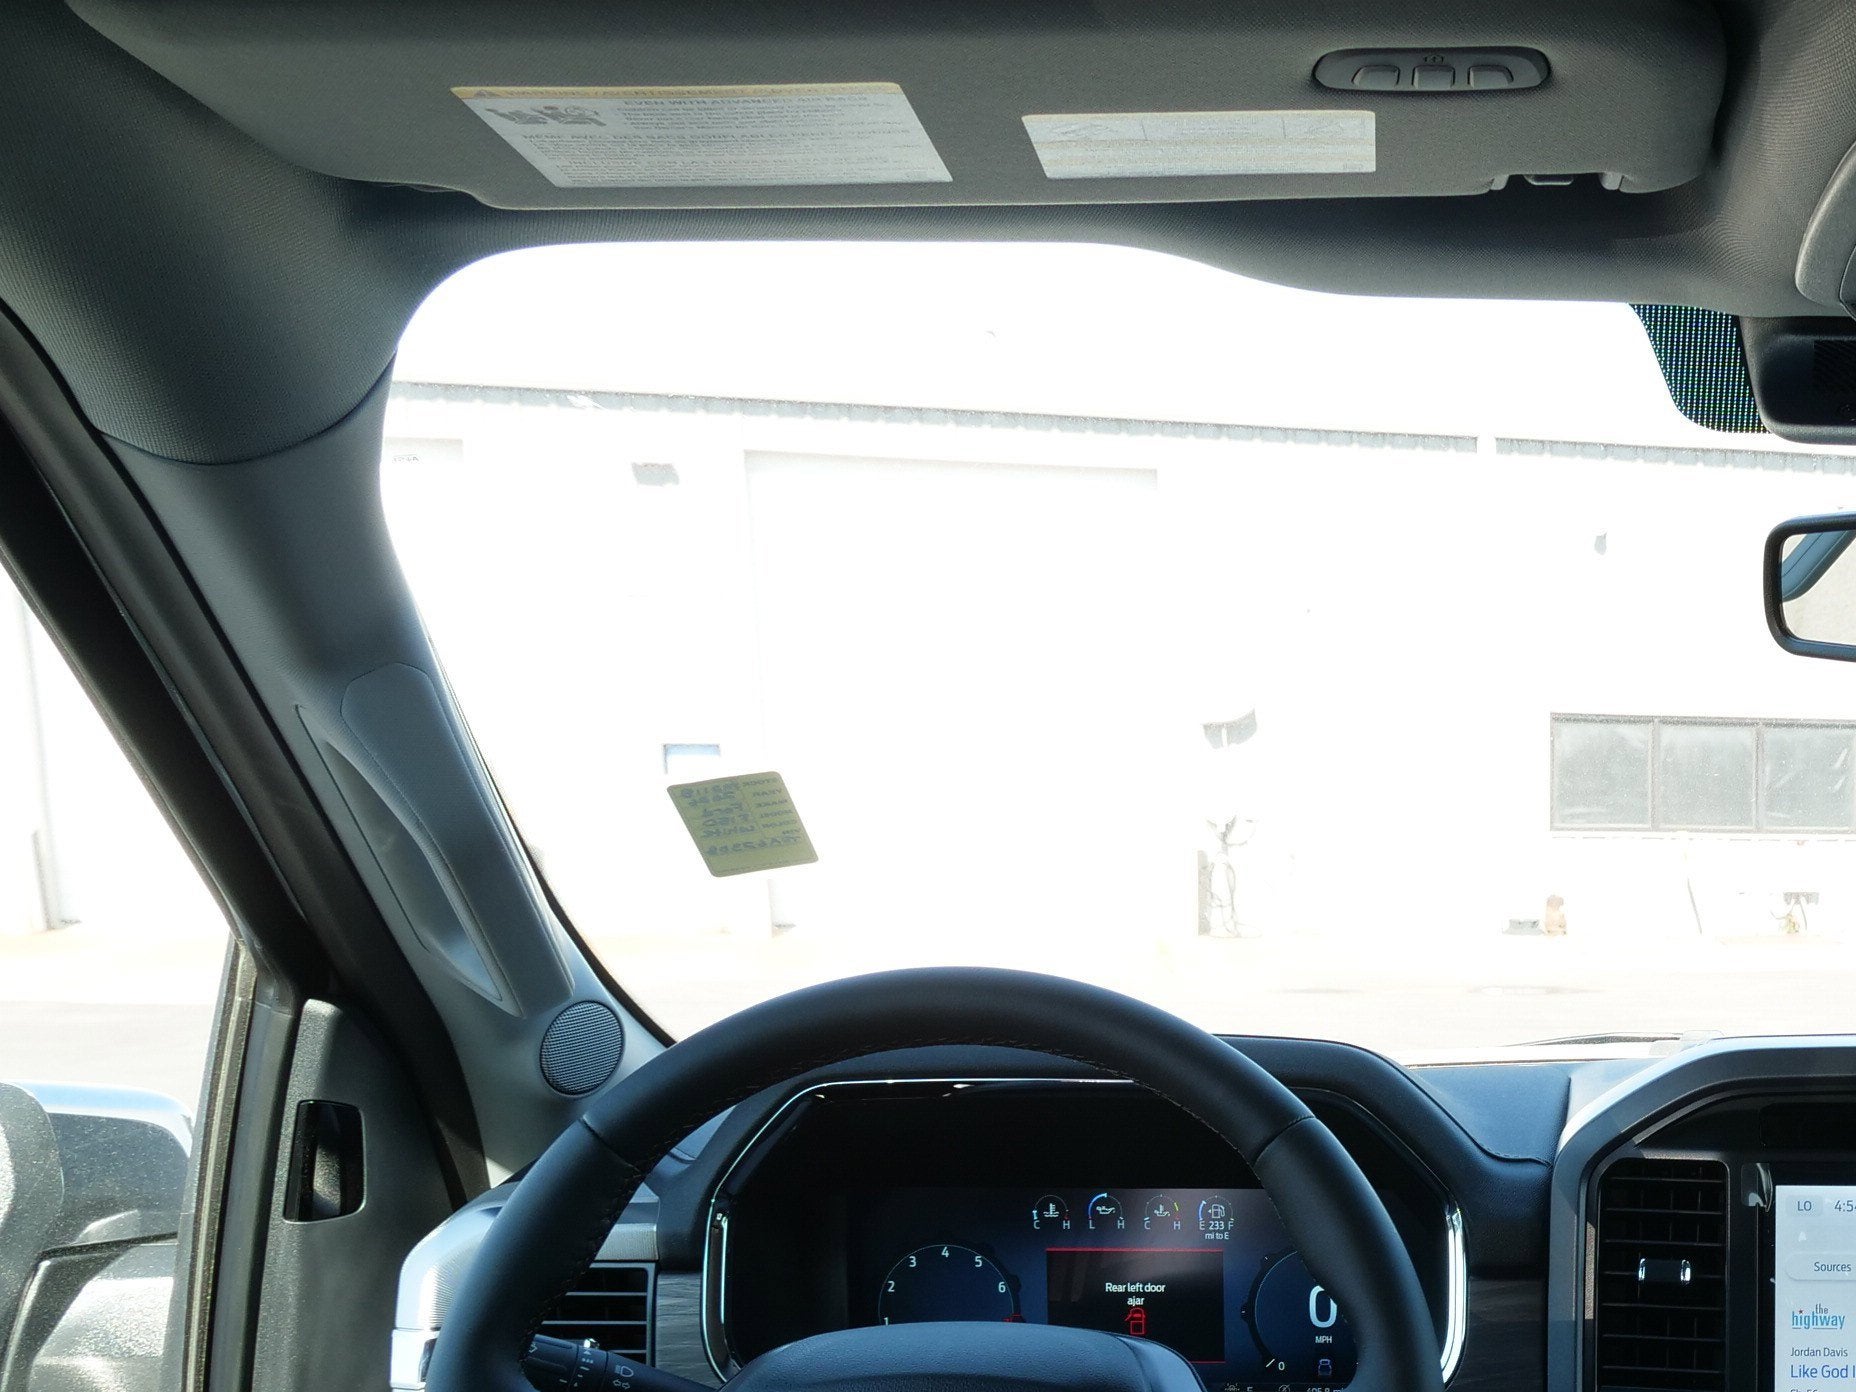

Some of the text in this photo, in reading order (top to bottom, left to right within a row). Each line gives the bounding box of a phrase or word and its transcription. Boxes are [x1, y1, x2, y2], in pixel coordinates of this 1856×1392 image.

[1797, 1200, 1812, 1212] LO
[1208, 1220, 1225, 1230] 233
[1204, 1232, 1215, 1240] mi
[941, 1246, 949, 1258] 4
[909, 1255, 917, 1268] 3
[974, 1255, 983, 1268] 5
[1813, 1261, 1852, 1273] Sources
[887, 1280, 895, 1292] 2
[998, 1281, 1006, 1293] 6
[1105, 1281, 1166, 1293] Rear left door
[1127, 1295, 1145, 1307] ajar
[1309, 1284, 1338, 1329] 0
[1815, 1303, 1829, 1315] the
[1791, 1309, 1846, 1330] highway
[1315, 1335, 1333, 1344] MPH
[1790, 1347, 1848, 1358] Jordan Davis
[1277, 1361, 1286, 1371] 0
[1790, 1364, 1818, 1379] Like
[1820, 1364, 1849, 1379] God
